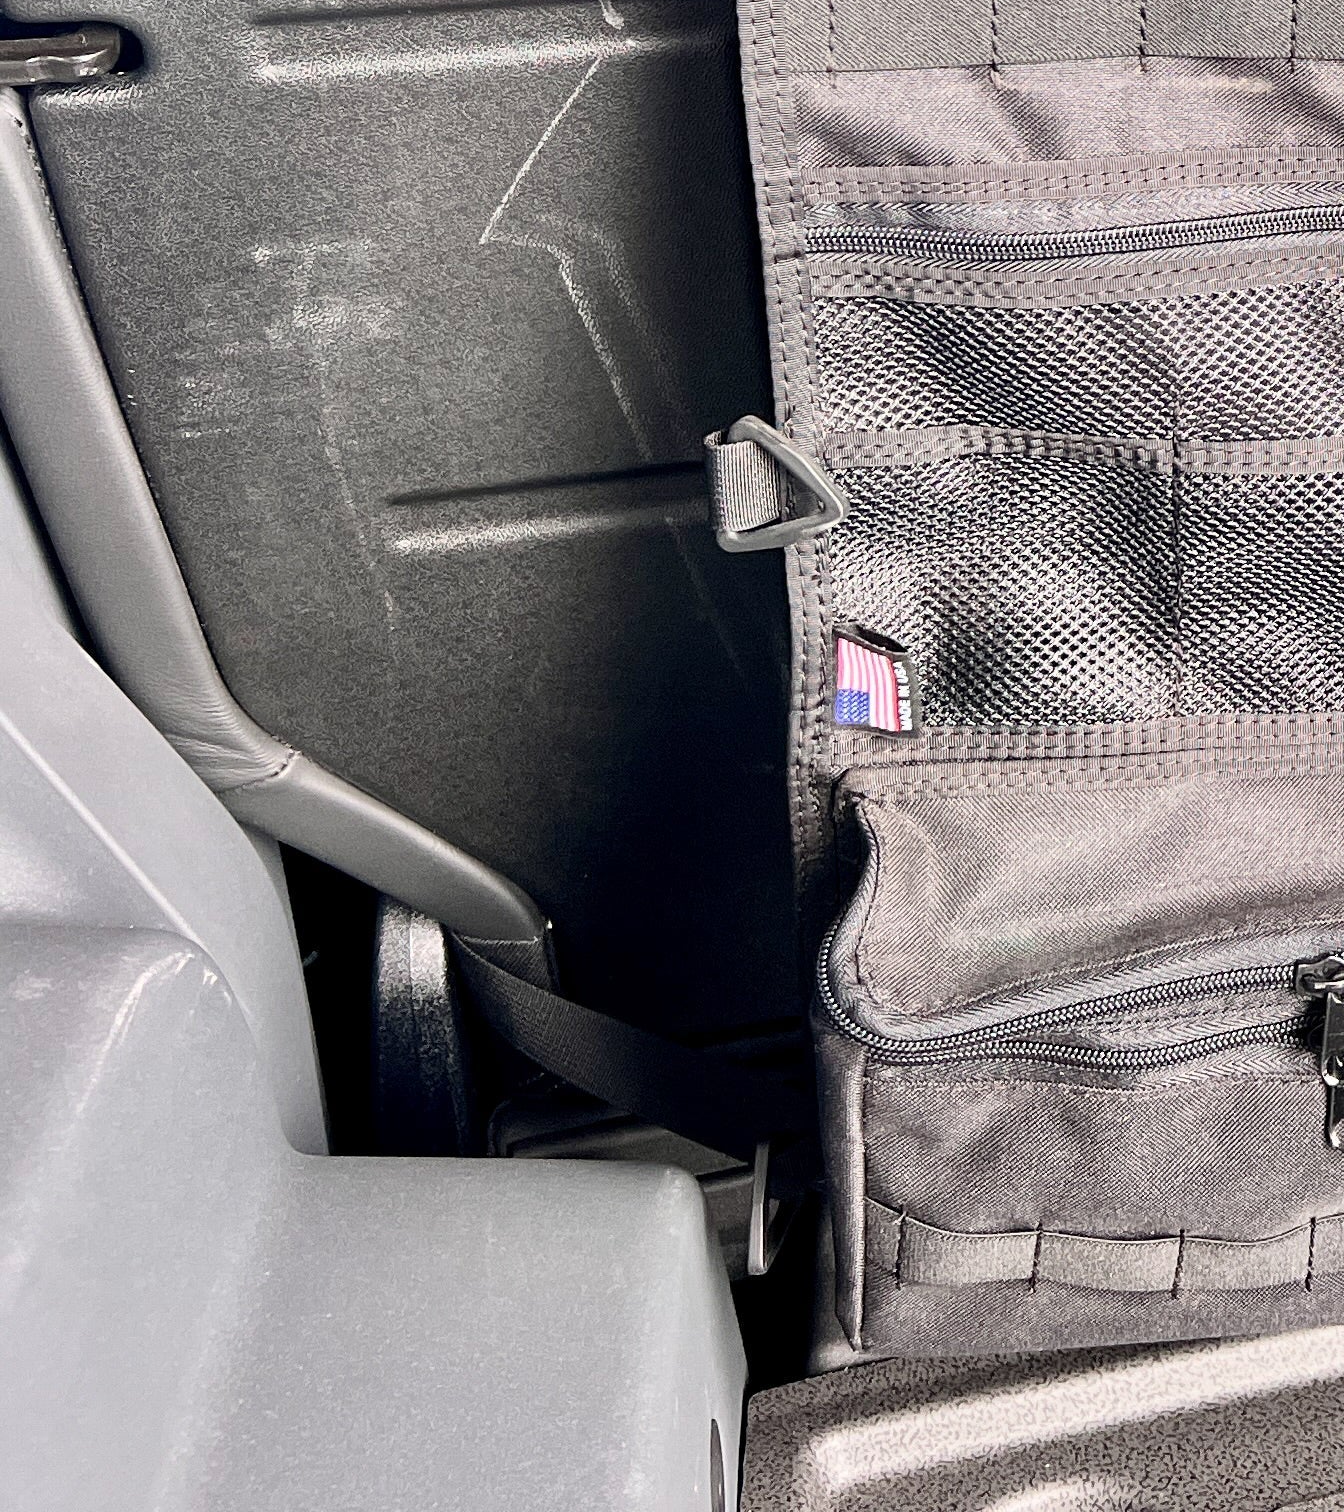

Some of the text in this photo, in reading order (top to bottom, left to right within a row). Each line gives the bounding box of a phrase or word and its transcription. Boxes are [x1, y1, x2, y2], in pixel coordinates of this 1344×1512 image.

[893, 661, 913, 730] MADE IN USA
